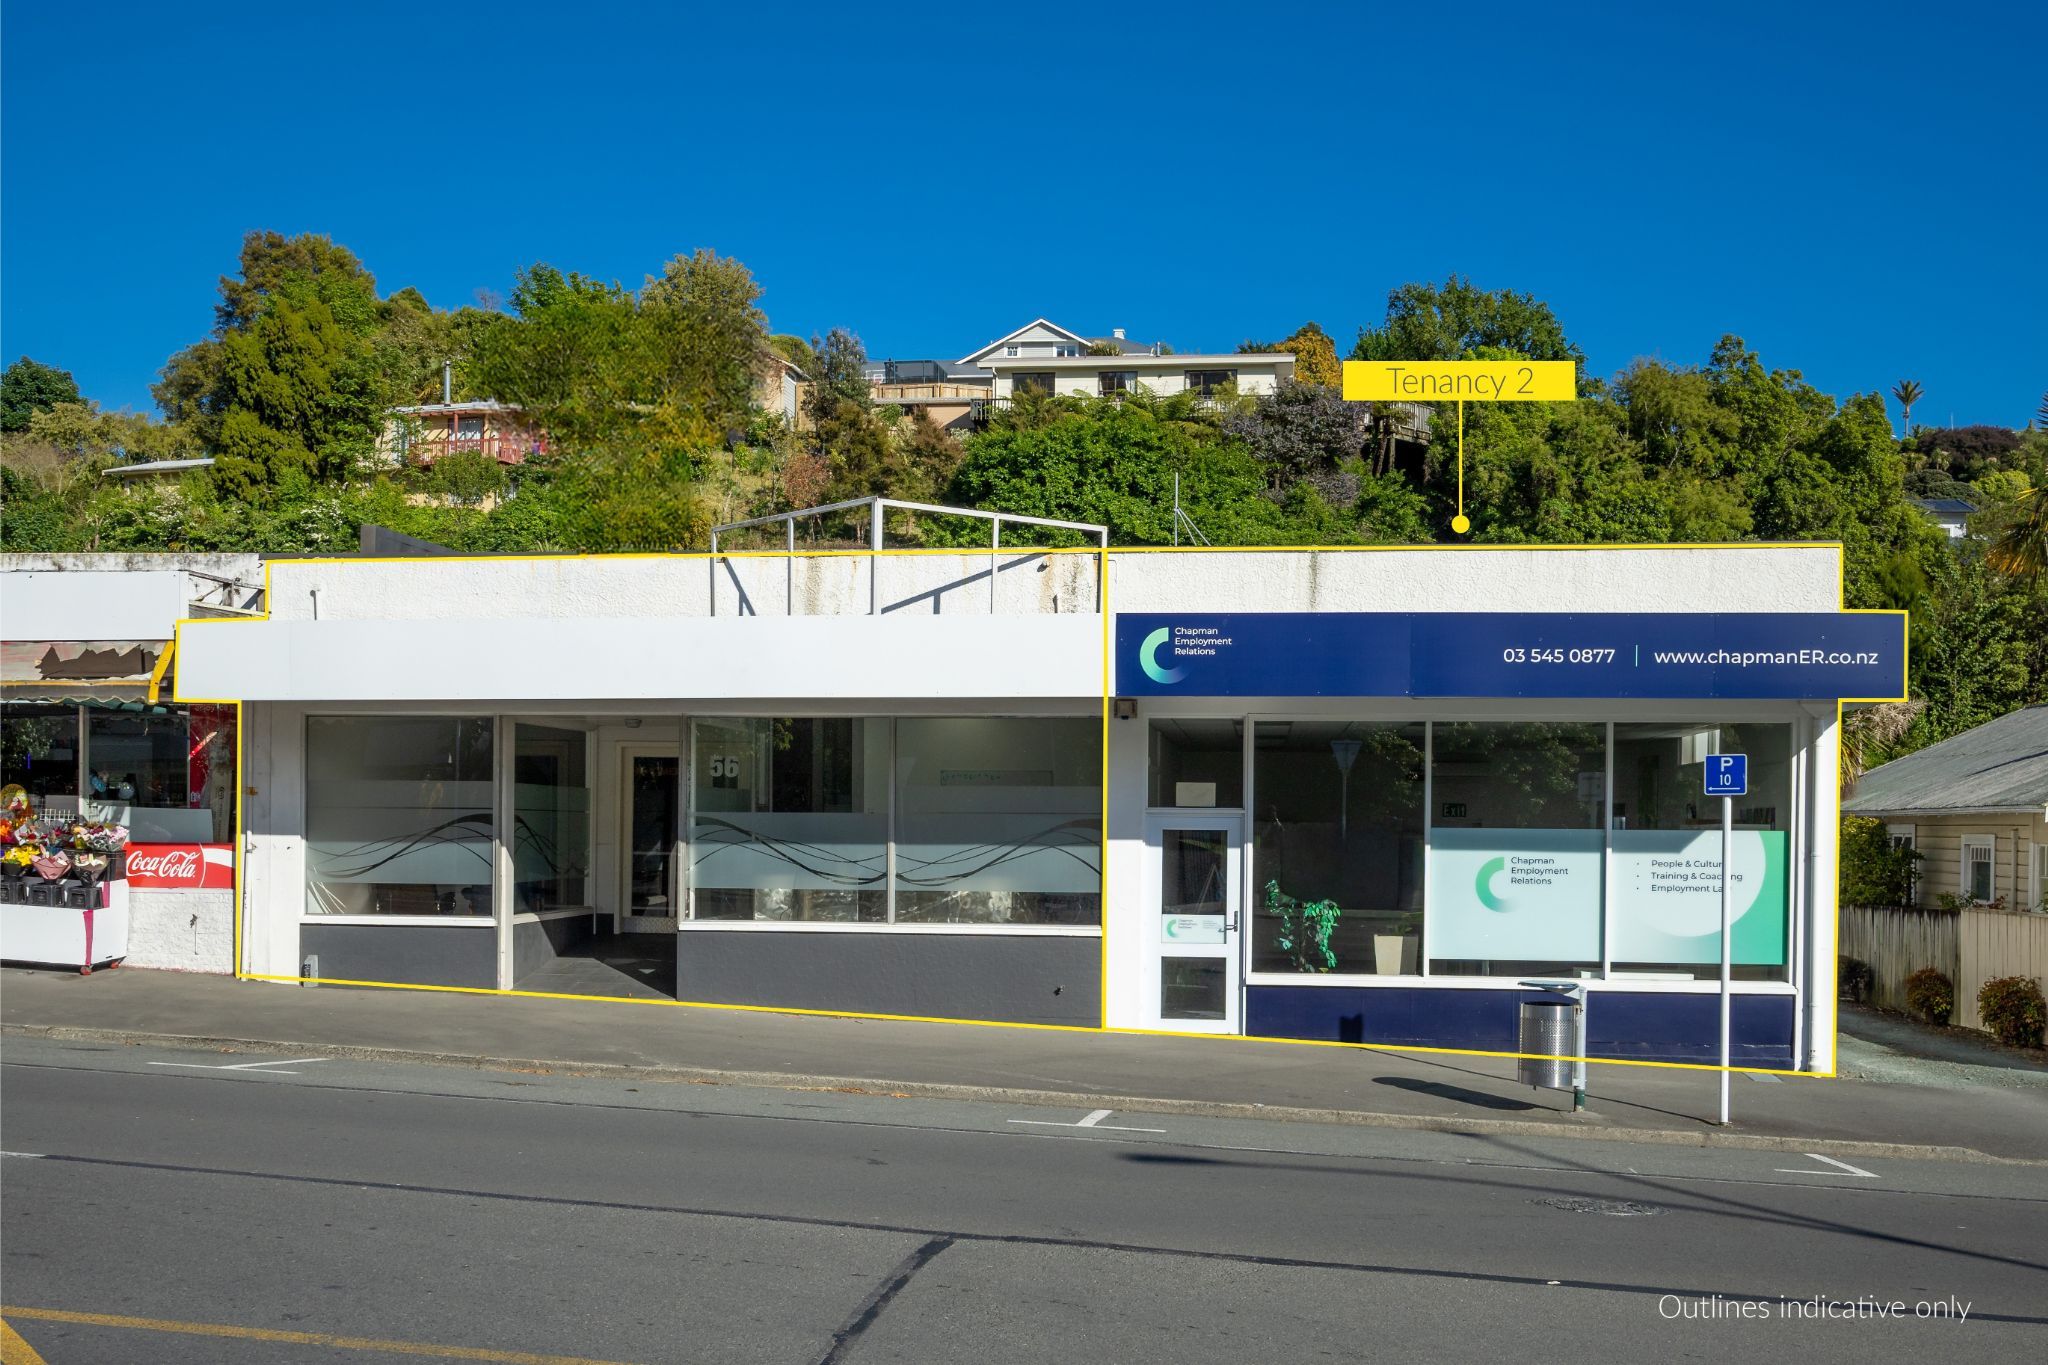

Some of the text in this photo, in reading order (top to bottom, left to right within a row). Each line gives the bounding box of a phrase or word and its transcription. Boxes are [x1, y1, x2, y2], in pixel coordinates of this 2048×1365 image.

[1174, 627, 1218, 636] Chapman
[1174, 637, 1233, 647] Employment
[1174, 647, 1216, 655] Relations
[1503, 649, 1879, 668] 03 545 0877 www.chapmanER.co.nz
[709, 755, 740, 778] 56
[1720, 757, 1734, 772] P
[1719, 774, 1732, 786] 10
[125, 850, 201, 878] Coca-Cola
[1510, 856, 1555, 866] Chapman
[1651, 859, 1723, 869] People & Cultur
[1511, 867, 1569, 876] Employment
[1510, 877, 1552, 885] Relations
[1651, 872, 1743, 882] Training & Coacng
[1651, 884, 1727, 893] Employment La
